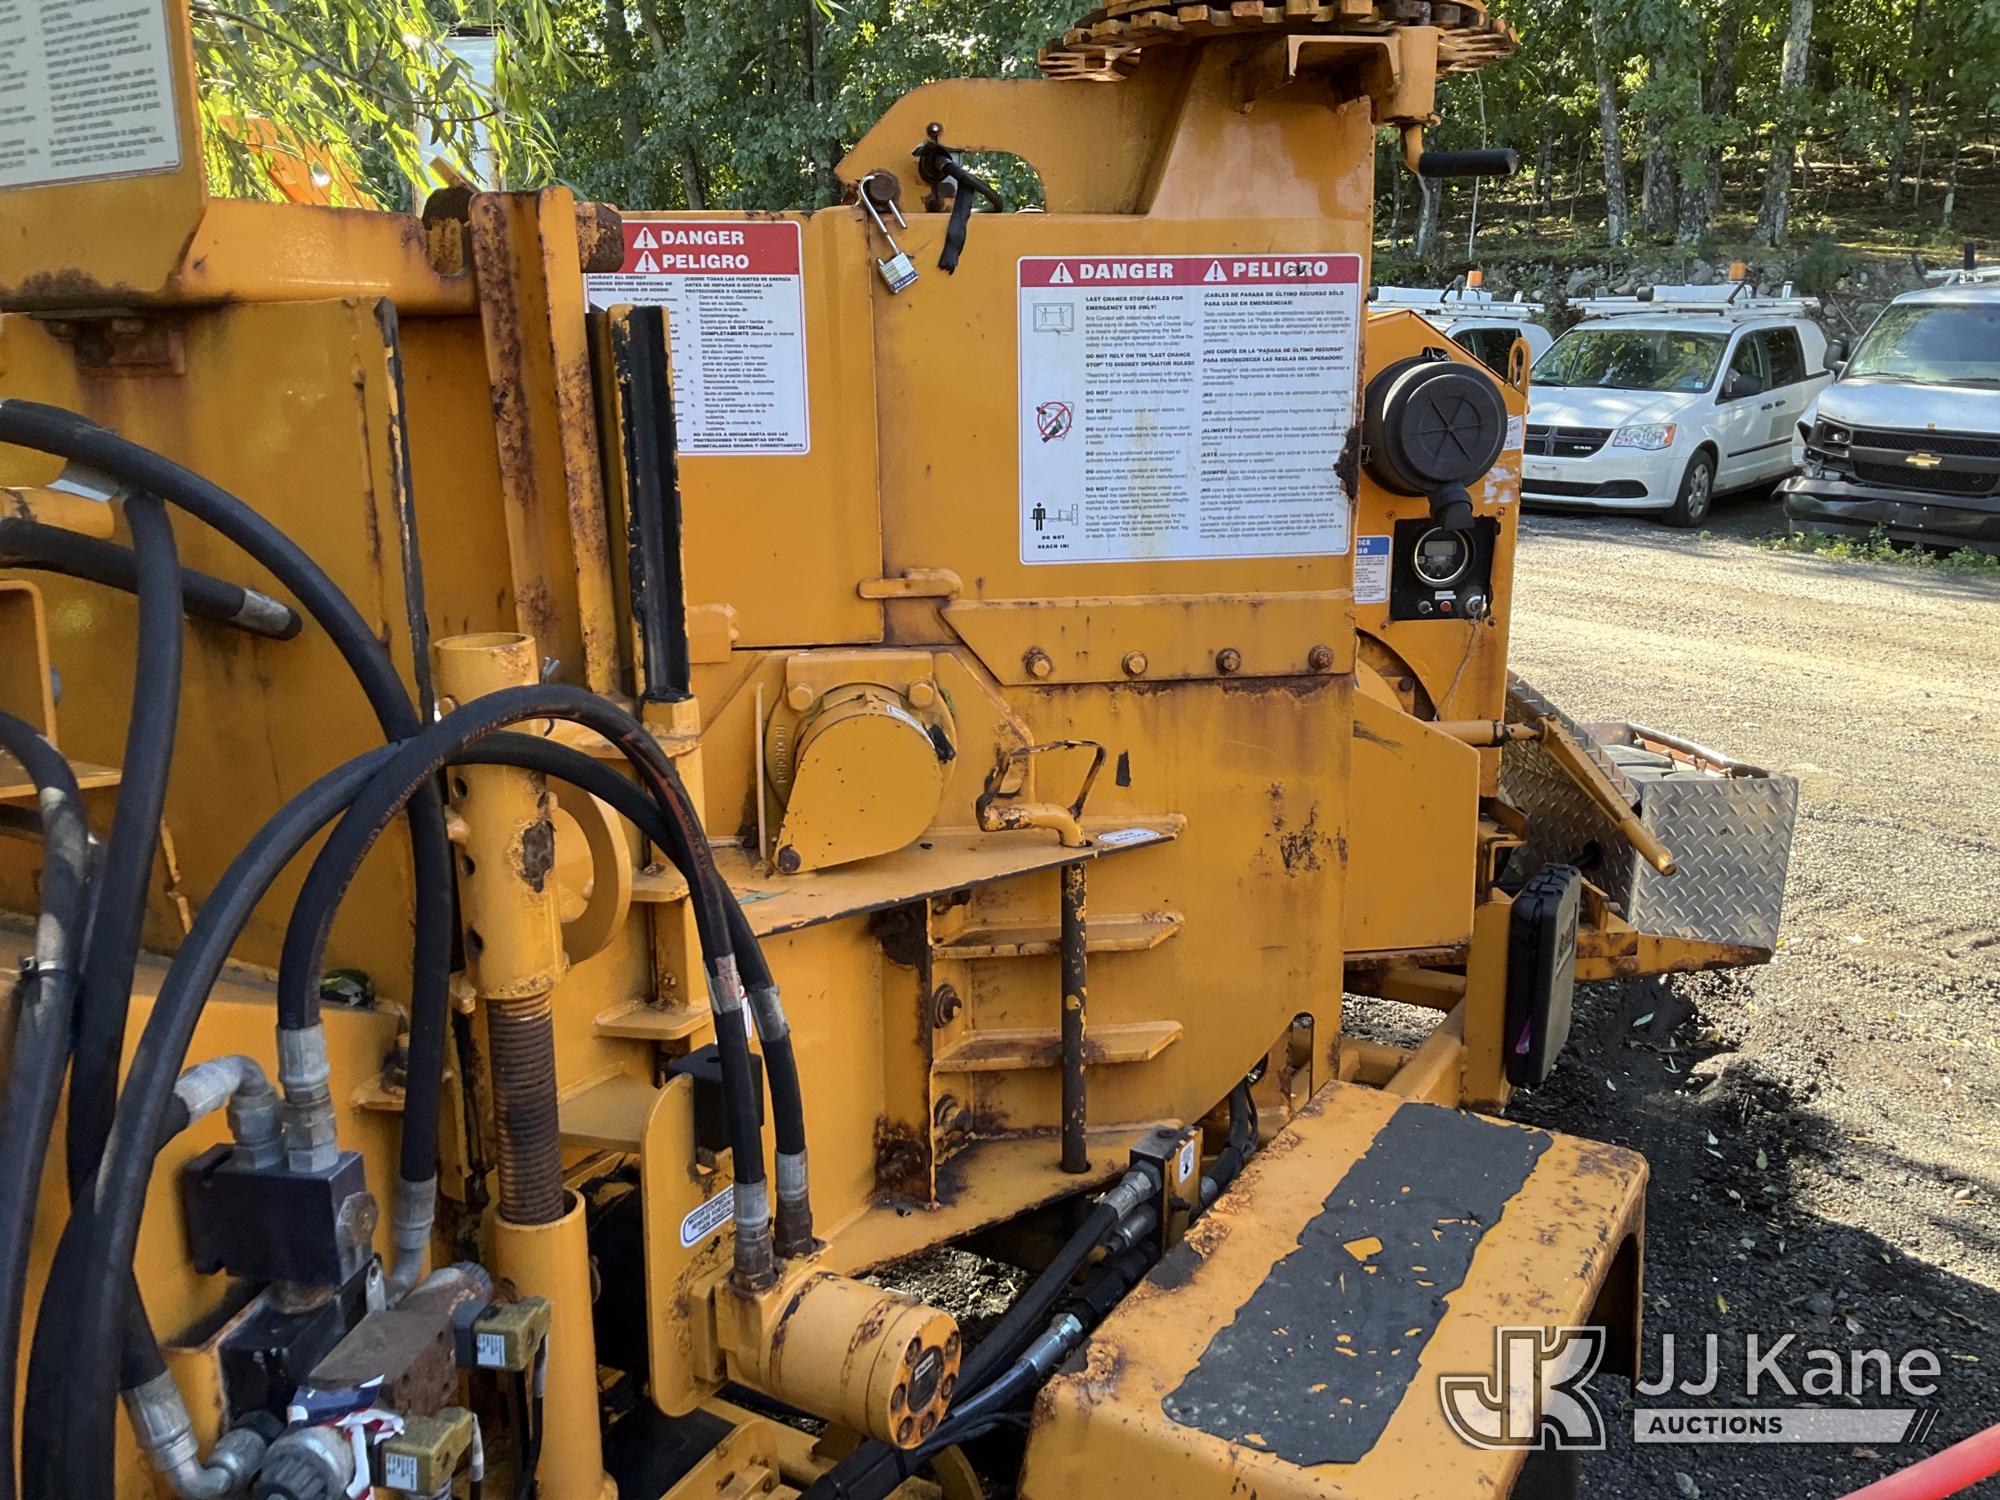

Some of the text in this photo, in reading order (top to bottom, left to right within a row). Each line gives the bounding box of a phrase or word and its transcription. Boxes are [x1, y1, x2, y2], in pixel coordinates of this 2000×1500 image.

[661, 230, 744, 246] DANGER
[662, 255, 749, 270] PELIGRO
[1080, 262, 1174, 279] DANGER
[1233, 260, 1328, 277] PELIGRO
[892, 272, 915, 289] Master
[776, 726, 787, 784] REXNORD
